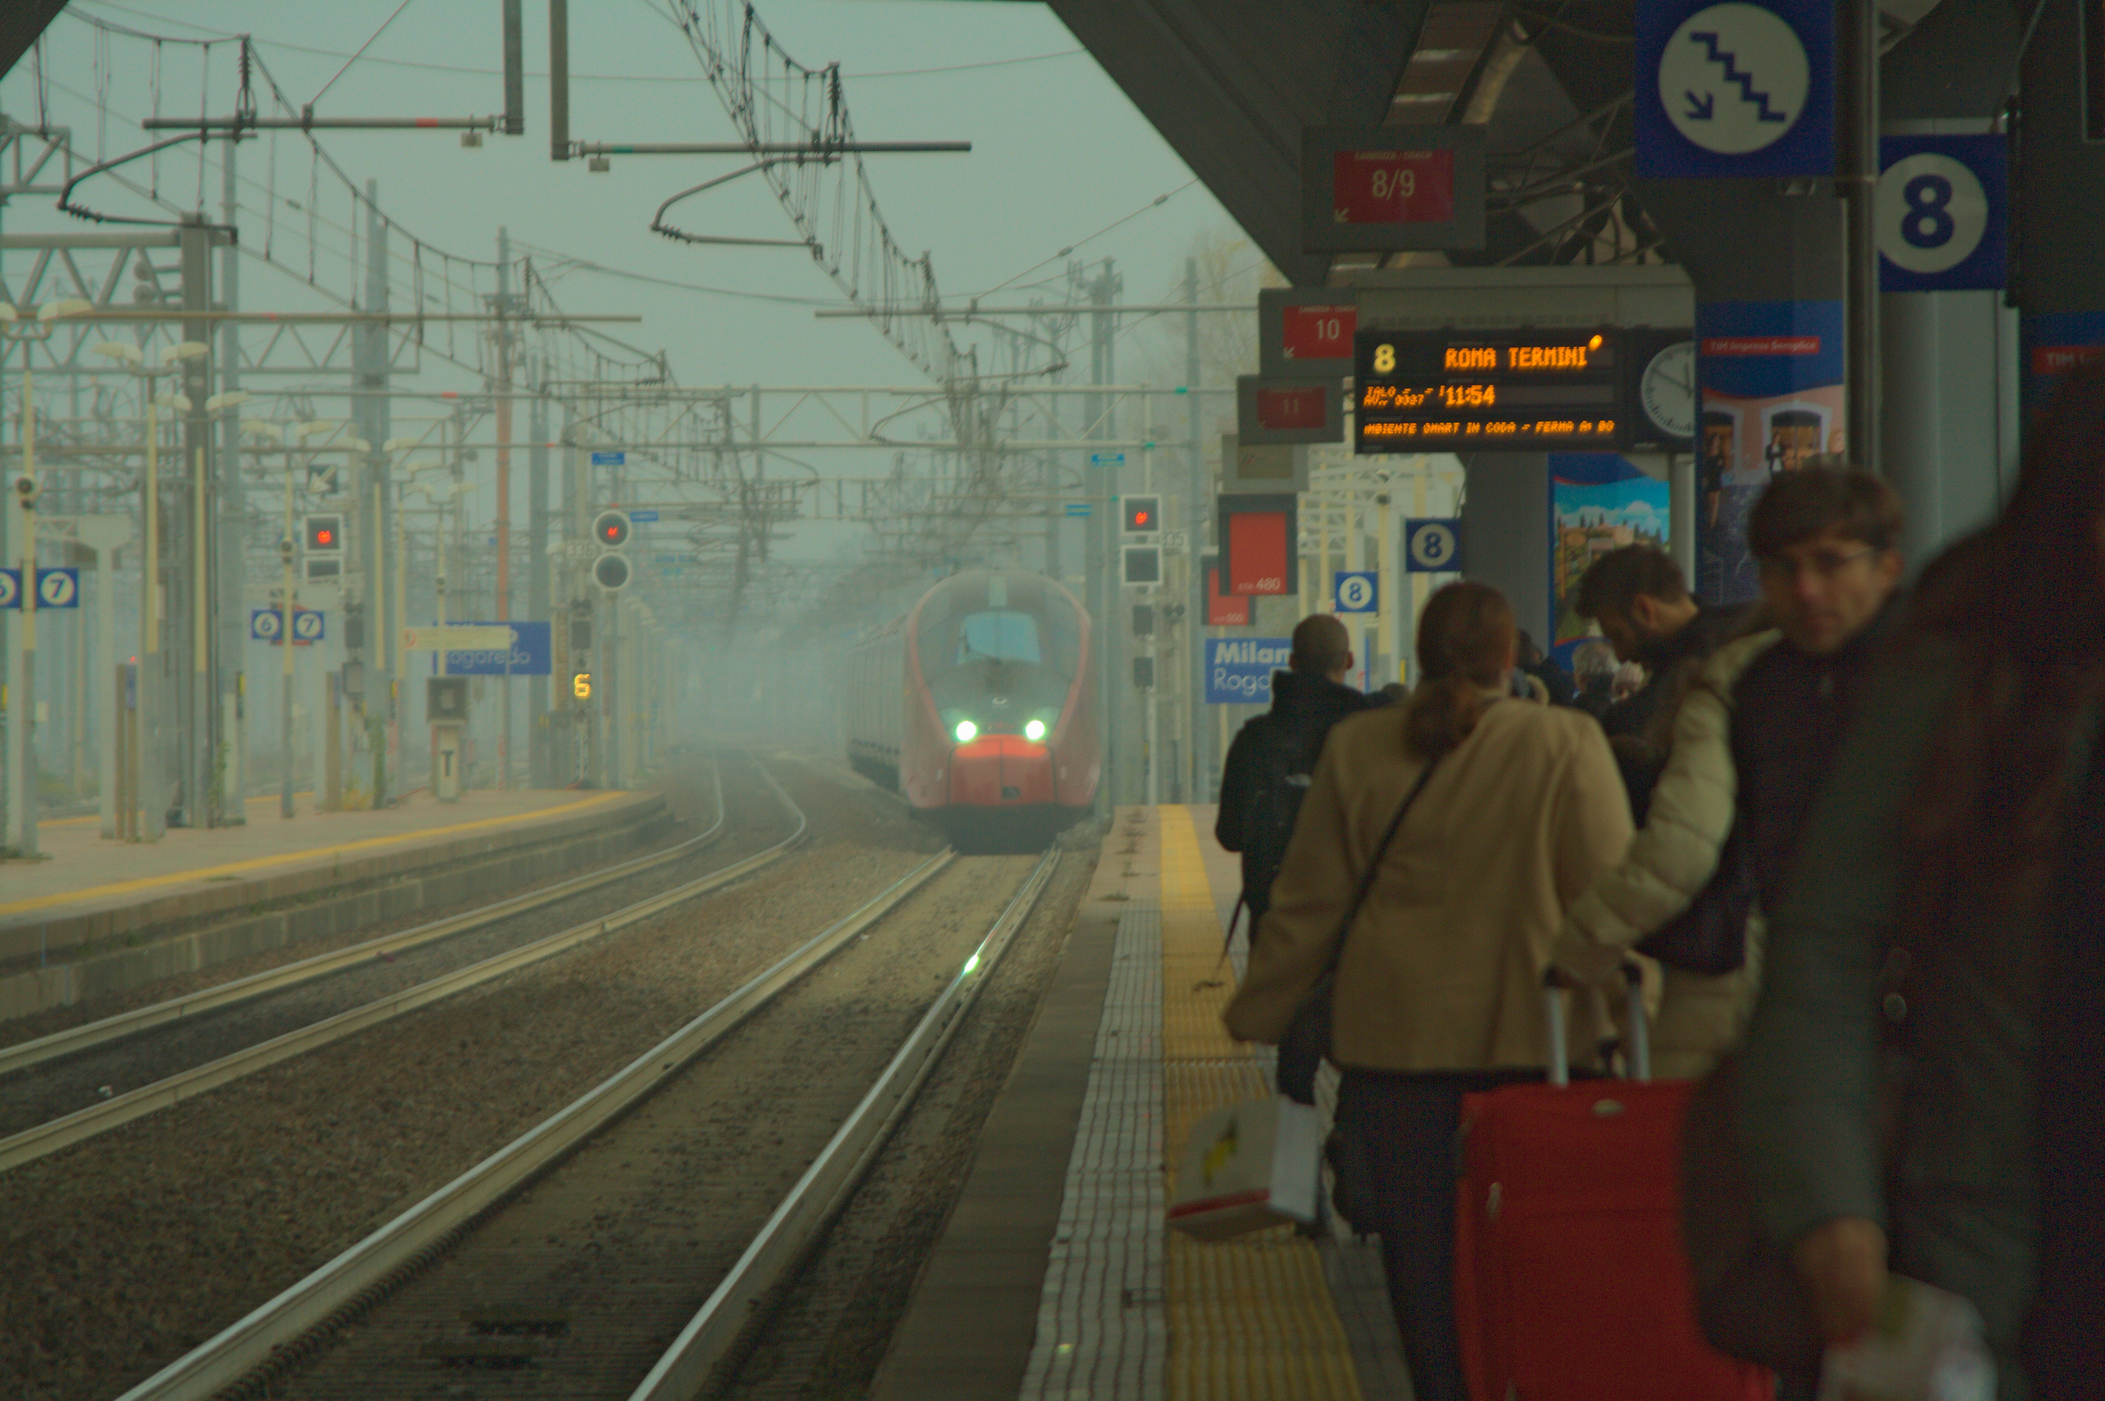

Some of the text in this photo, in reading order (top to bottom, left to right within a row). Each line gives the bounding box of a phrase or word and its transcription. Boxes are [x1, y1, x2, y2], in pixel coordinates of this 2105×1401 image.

[1372, 169, 1415, 200] 8/9
[1901, 174, 1956, 249] 8
[1316, 318, 1341, 340] 10
[1373, 343, 1587, 372] 8 ROMA TERMINI
[1710, 341, 1728, 352] TIM
[1282, 398, 1299, 414] 11
[1446, 384, 1496, 406] 11:54
[1423, 532, 1443, 559] 8
[51, 579, 65, 598] 7
[1255, 577, 1281, 591] 480
[1348, 582, 1363, 602] 8
[261, 615, 273, 633] 6
[304, 616, 315, 633] 7
[574, 673, 591, 697] 6
[441, 749, 454, 777] T
